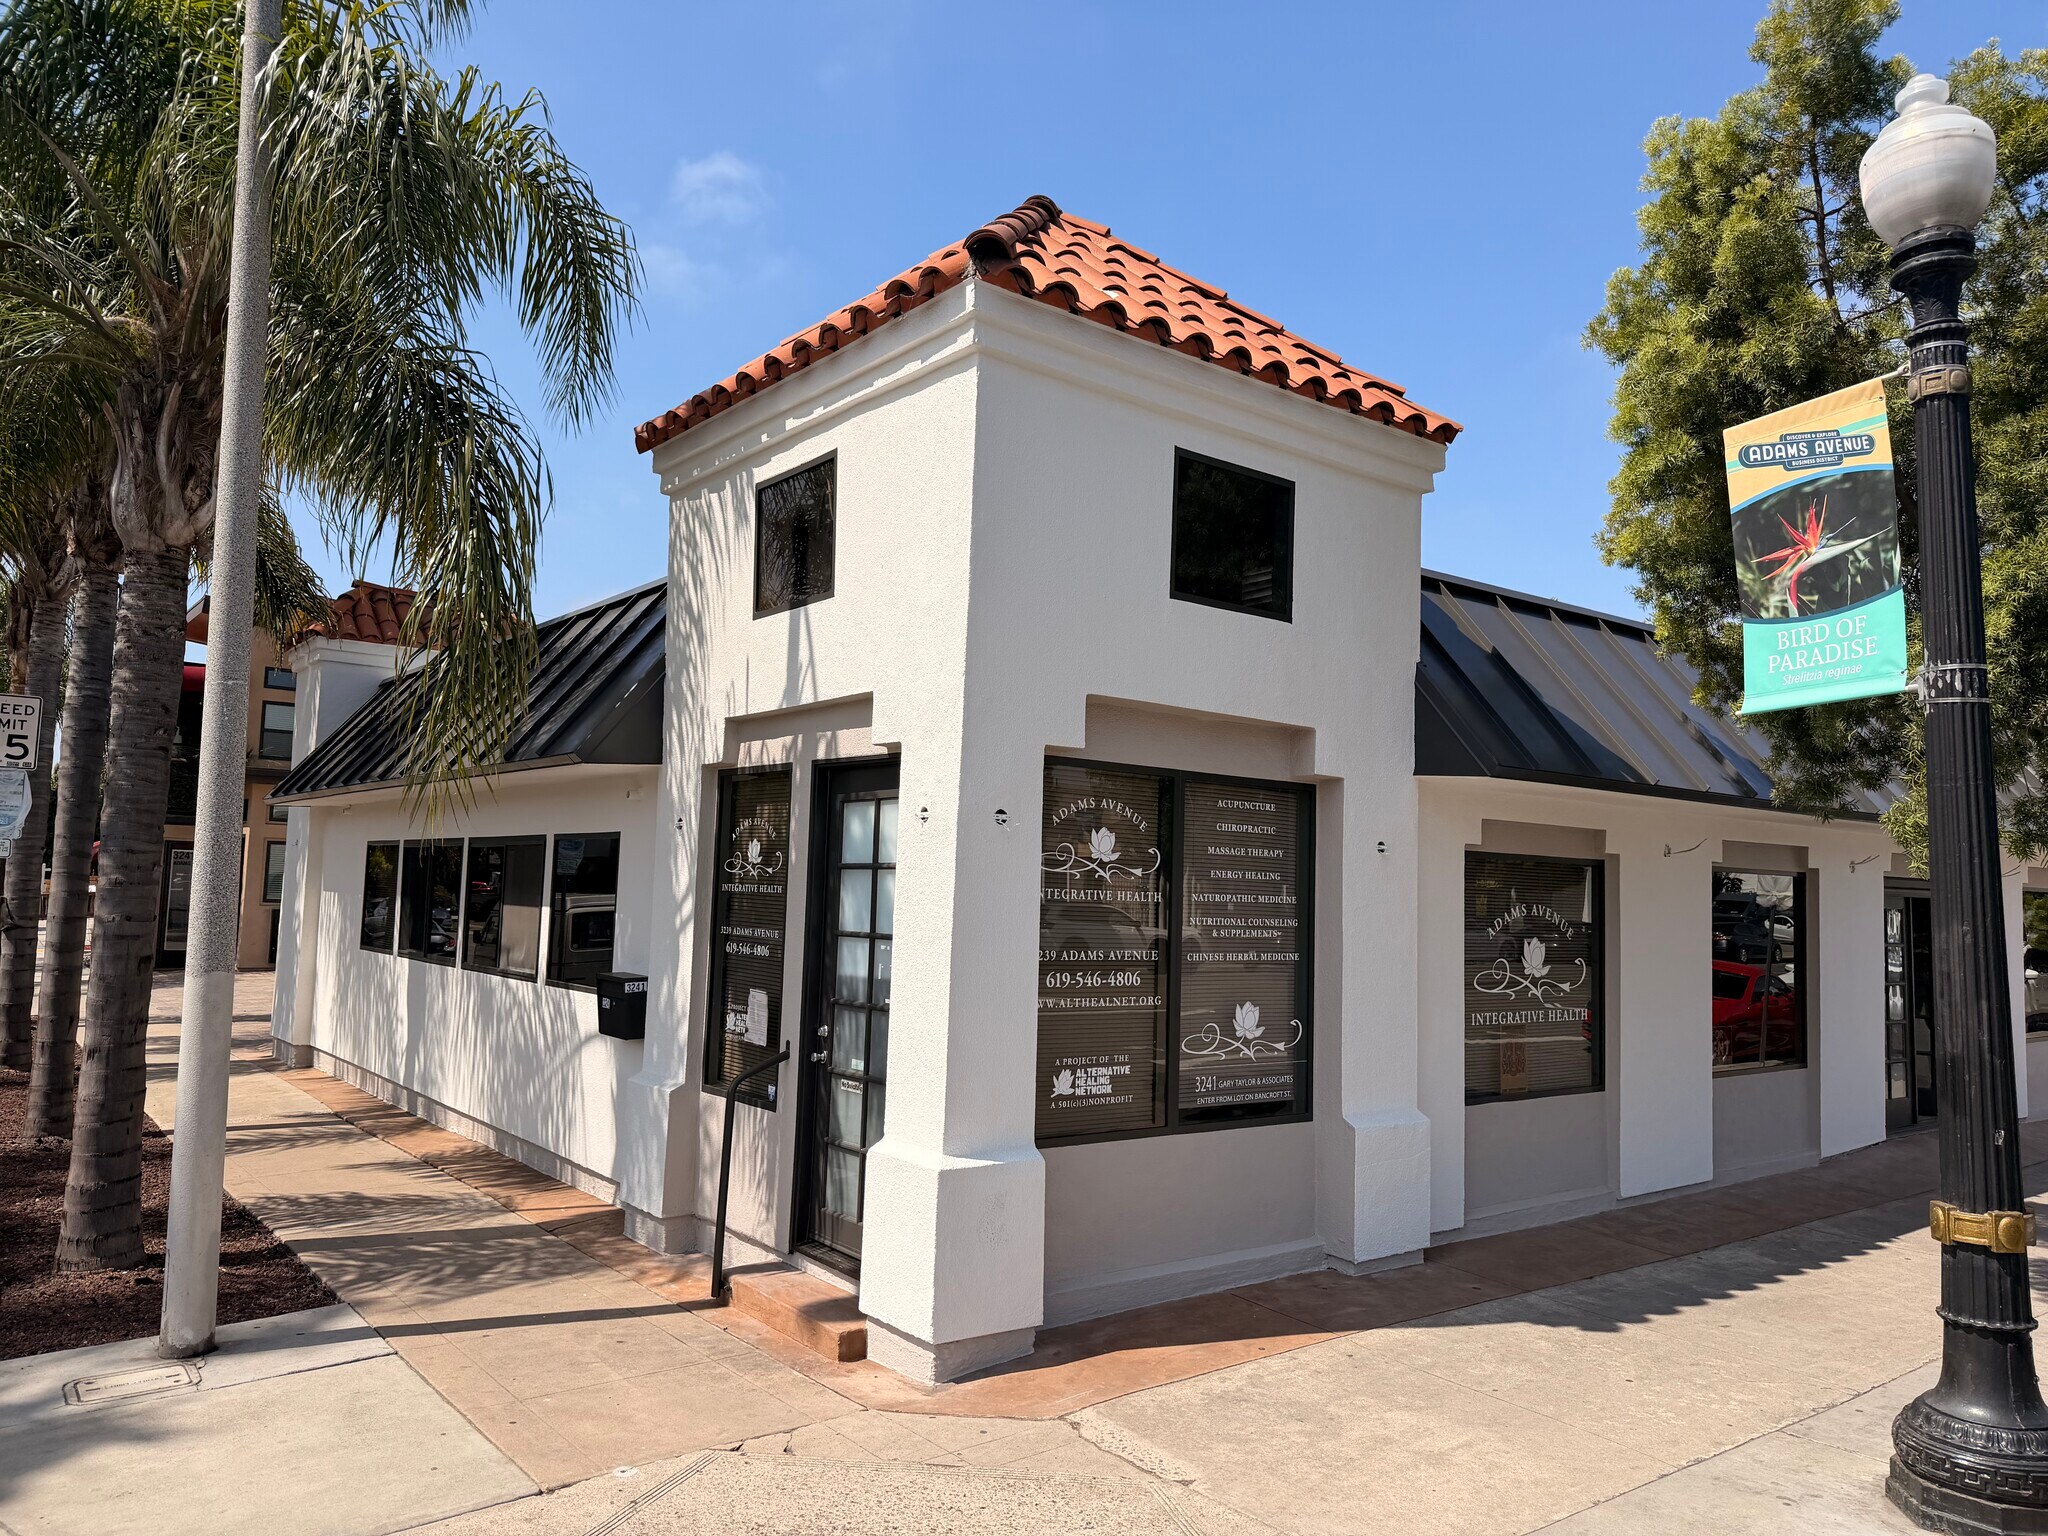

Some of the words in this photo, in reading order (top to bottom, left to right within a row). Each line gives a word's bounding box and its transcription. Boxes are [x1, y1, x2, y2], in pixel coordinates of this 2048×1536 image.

[1786, 433, 1811, 441] DISCOVER
[1749, 442, 1809, 462] ADAMS
[1815, 436, 1870, 455] AVENUE
[1792, 459, 1815, 467] BUSINESS
[1816, 456, 1838, 464] DISTRICT
[1776, 623, 1830, 651] BIRD
[1836, 614, 1867, 639] OF
[1767, 635, 1879, 674] PARADISE
[1782, 669, 1822, 686] Strelitzia
[1825, 663, 1863, 680] reginae
[0, 703, 35, 716] EED
[0, 718, 27, 730] MIT
[4, 734, 29, 760] 5
[1217, 800, 1276, 812] ACUPUNCTURE
[1051, 797, 1096, 827] ADAMS
[1100, 798, 1148, 832] AVENUE
[732, 817, 752, 841] ADAMS
[753, 817, 777, 840] AVENUE
[1216, 823, 1277, 835] CHIROPRACTIC
[1207, 846, 1246, 856] MASSAGE
[1247, 848, 1284, 858] THERAPY
[1210, 870, 1244, 879] ENERGY
[1245, 872, 1281, 881] HEALING
[721, 883, 758, 893] INTEGRATIVE
[759, 884, 782, 894] HEALTH
[1117, 890, 1162, 902] HEALTH
[1192, 893, 1257, 903] NATUROPATHIC
[1257, 895, 1297, 904] MEDICINE
[1189, 917, 1247, 926] NUTRITIONAL
[1248, 918, 1298, 927] COUNSELING
[1487, 903, 1528, 940] ADAMS
[1531, 903, 1575, 940] AVENUE
[732, 927, 753, 936] ADAMS
[753, 929, 780, 939] AVENUE
[1212, 929, 1218, 937] &
[1219, 929, 1278, 938] SUPPLEMENTS
[725, 940, 770, 957] 619-546-4806
[1038, 950, 1057, 961] 239
[1060, 950, 1105, 961] ADAMS
[1108, 950, 1159, 961] AVENUE
[1187, 953, 1225, 961] CHINESE
[1226, 953, 1259, 961] HERBAL
[1260, 952, 1300, 961] MEDICINE
[1046, 970, 1141, 989] 619-546-4806
[626, 982, 646, 992] 3241
[1038, 996, 1162, 1009] WW.ALTHEALNET.ORG
[1471, 1010, 1545, 1026] INTEGRATIVE
[1548, 1008, 1588, 1022] HEALTH
[1062, 1056, 1097, 1067] PROJECT
[1099, 1055, 1110, 1063] OF
[1113, 1054, 1130, 1062] THE
[1076, 1065, 1131, 1077] ALTERNATIVE
[1075, 1076, 1110, 1086] HEALING
[1195, 1075, 1217, 1092] 3241
[1218, 1080, 1235, 1088] GARY
[1235, 1078, 1256, 1087] TAYLOR
[1256, 1077, 1261, 1085] &
[1261, 1075, 1294, 1085] ASSOCIATES
[1075, 1084, 1113, 1096] NETWORK
[1197, 1097, 1216, 1105] ENTER
[1216, 1095, 1233, 1103] FROM
[1233, 1094, 1244, 1102] LOT
[1254, 1090, 1284, 1100] BANCROFT
[1050, 1101, 1056, 1109] A
